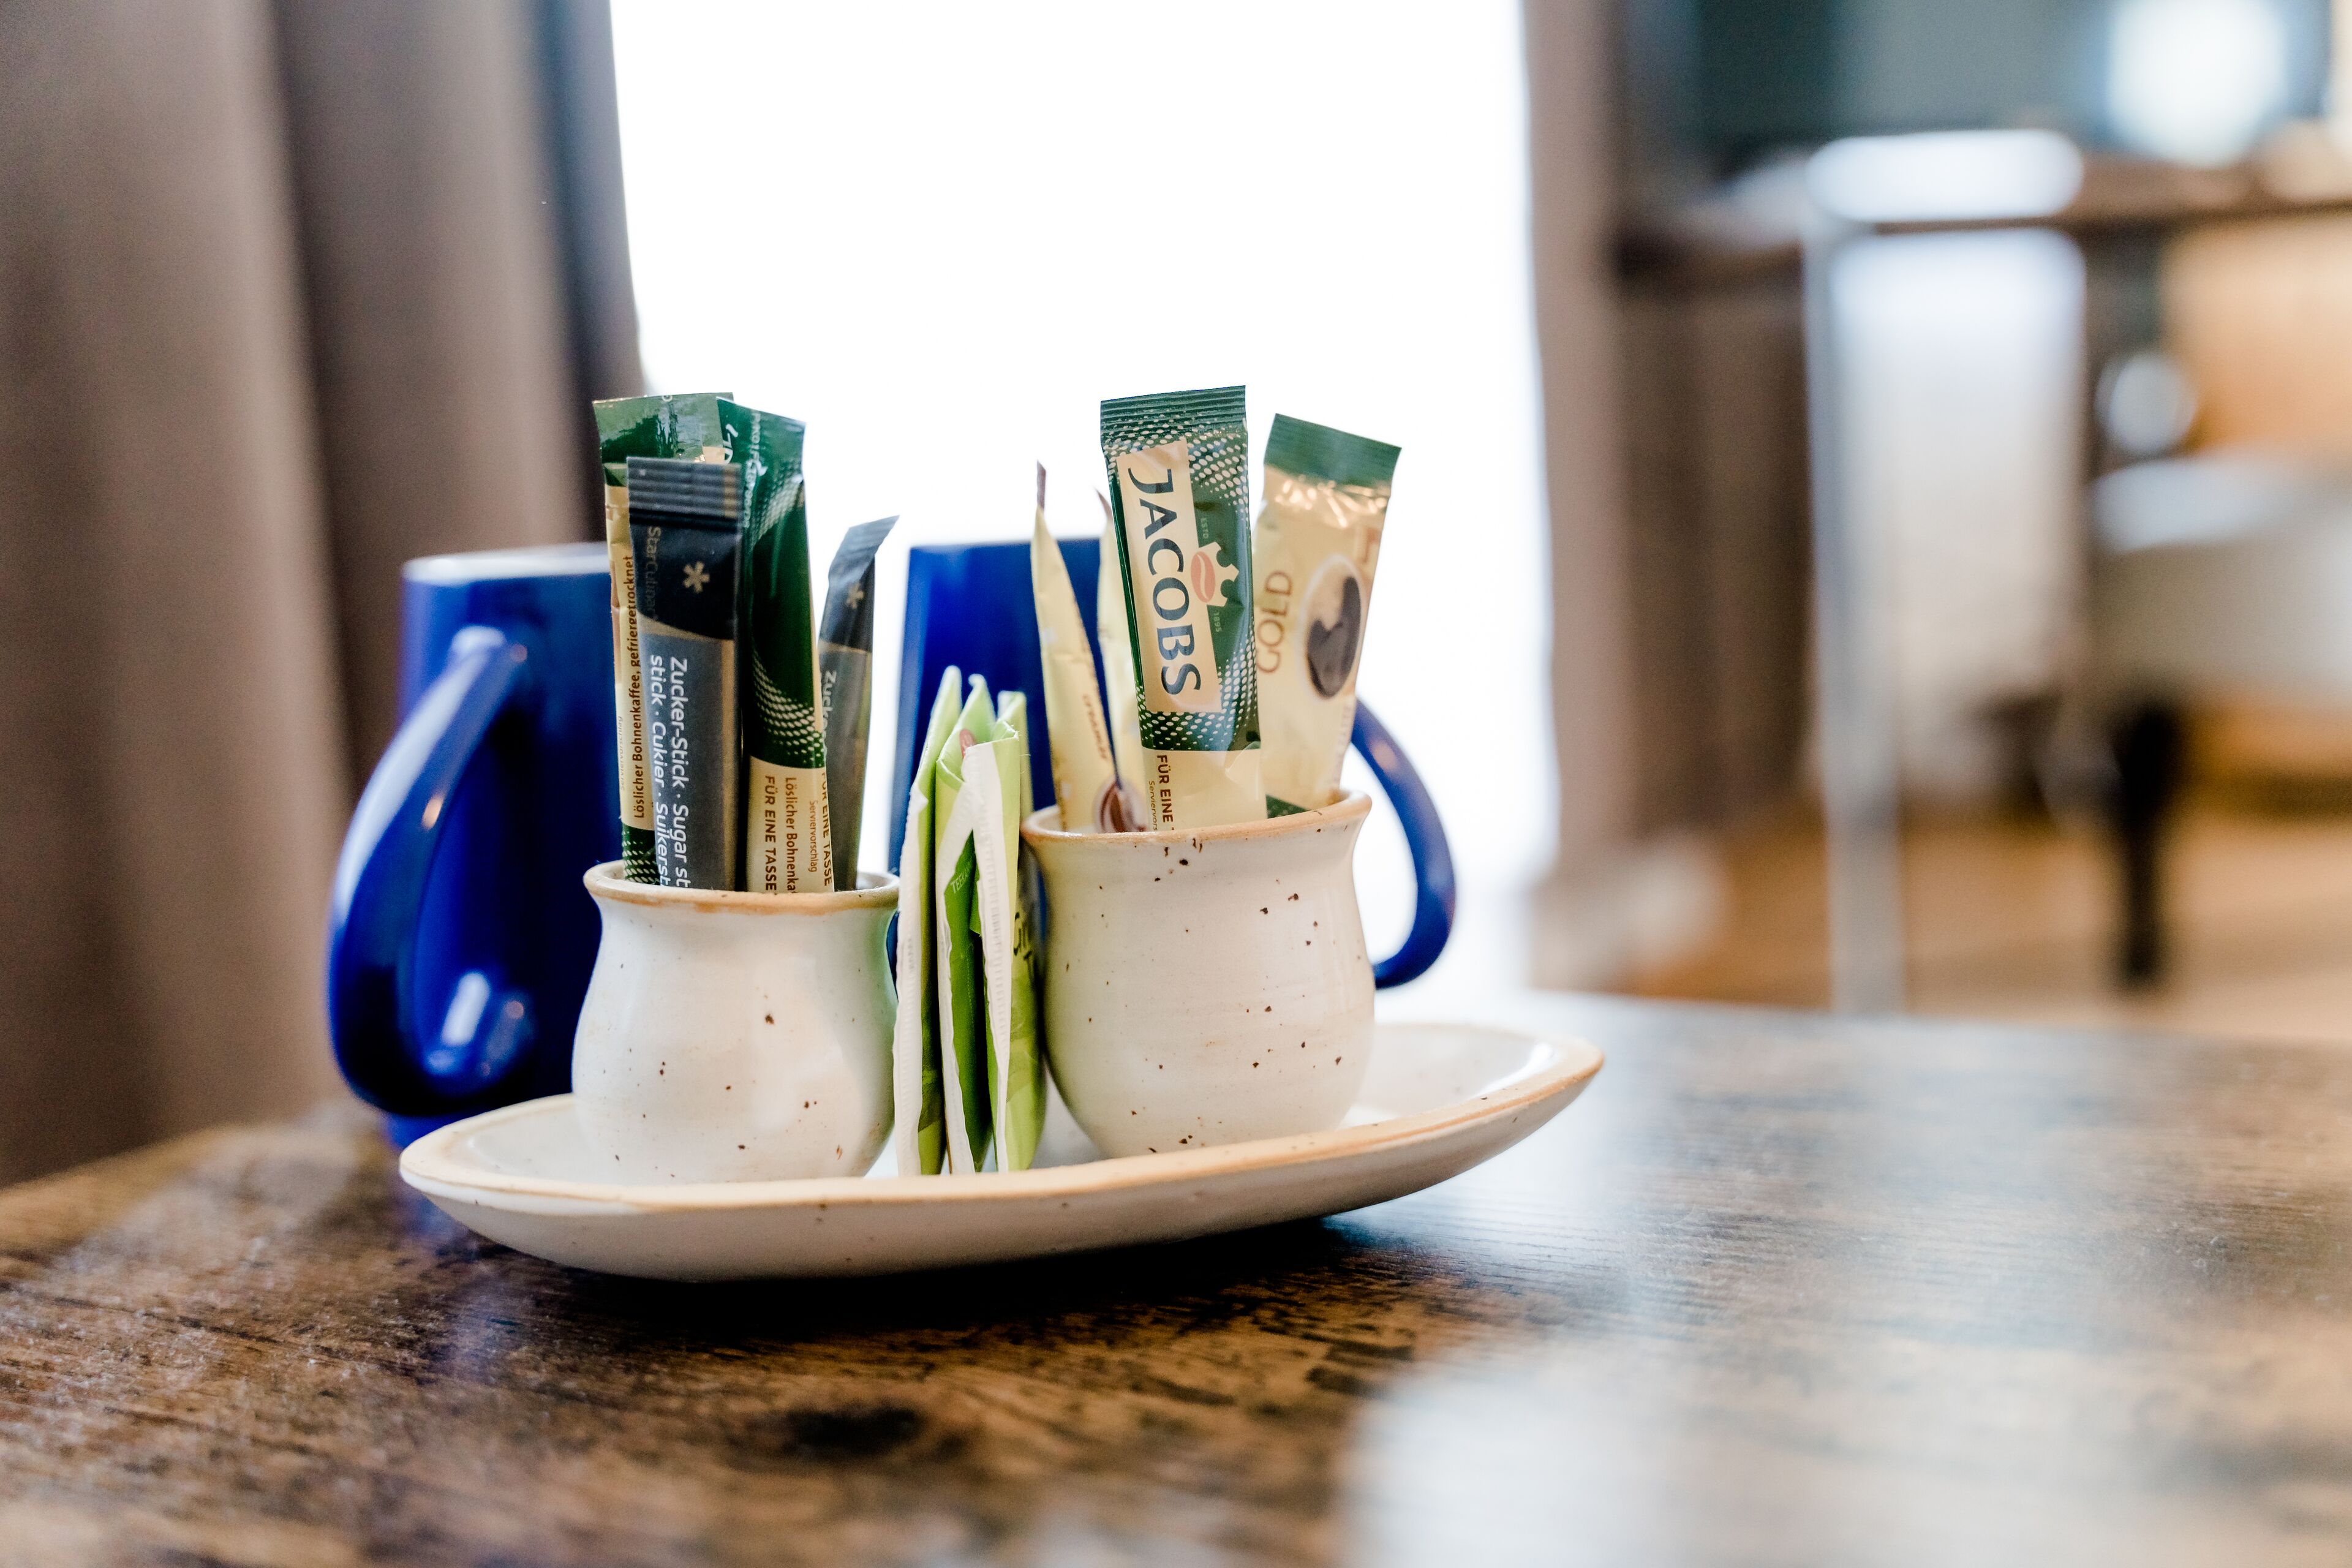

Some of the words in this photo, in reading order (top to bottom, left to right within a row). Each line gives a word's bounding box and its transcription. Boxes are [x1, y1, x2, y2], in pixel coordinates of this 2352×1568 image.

[1128, 467, 1201, 695] JACOBS
[623, 556, 640, 667] gefriergetrocknet
[1256, 570, 1293, 673] GOLD
[650, 655, 666, 706] stick
[628, 671, 643, 761] Bohnenkaffee,
[670, 656, 690, 789] Zucker-Stick
[652, 722, 668, 788] Cukier
[1156, 755, 1171, 784] FÜR
[633, 764, 644, 818] Löslicher
[764, 775, 778, 804] FÜR
[785, 777, 797, 829] Löslicher
[1148, 780, 1157, 831] Serviervors
[1160, 789, 1174, 823] EINE
[656, 802, 671, 886] Suikerst
[669, 803, 689, 863] Sugar
[764, 809, 777, 843] EINE
[809, 800, 819, 872] Serviervorschlag
[765, 848, 777, 891] TASSE
[786, 832, 799, 892] Bohnenka
